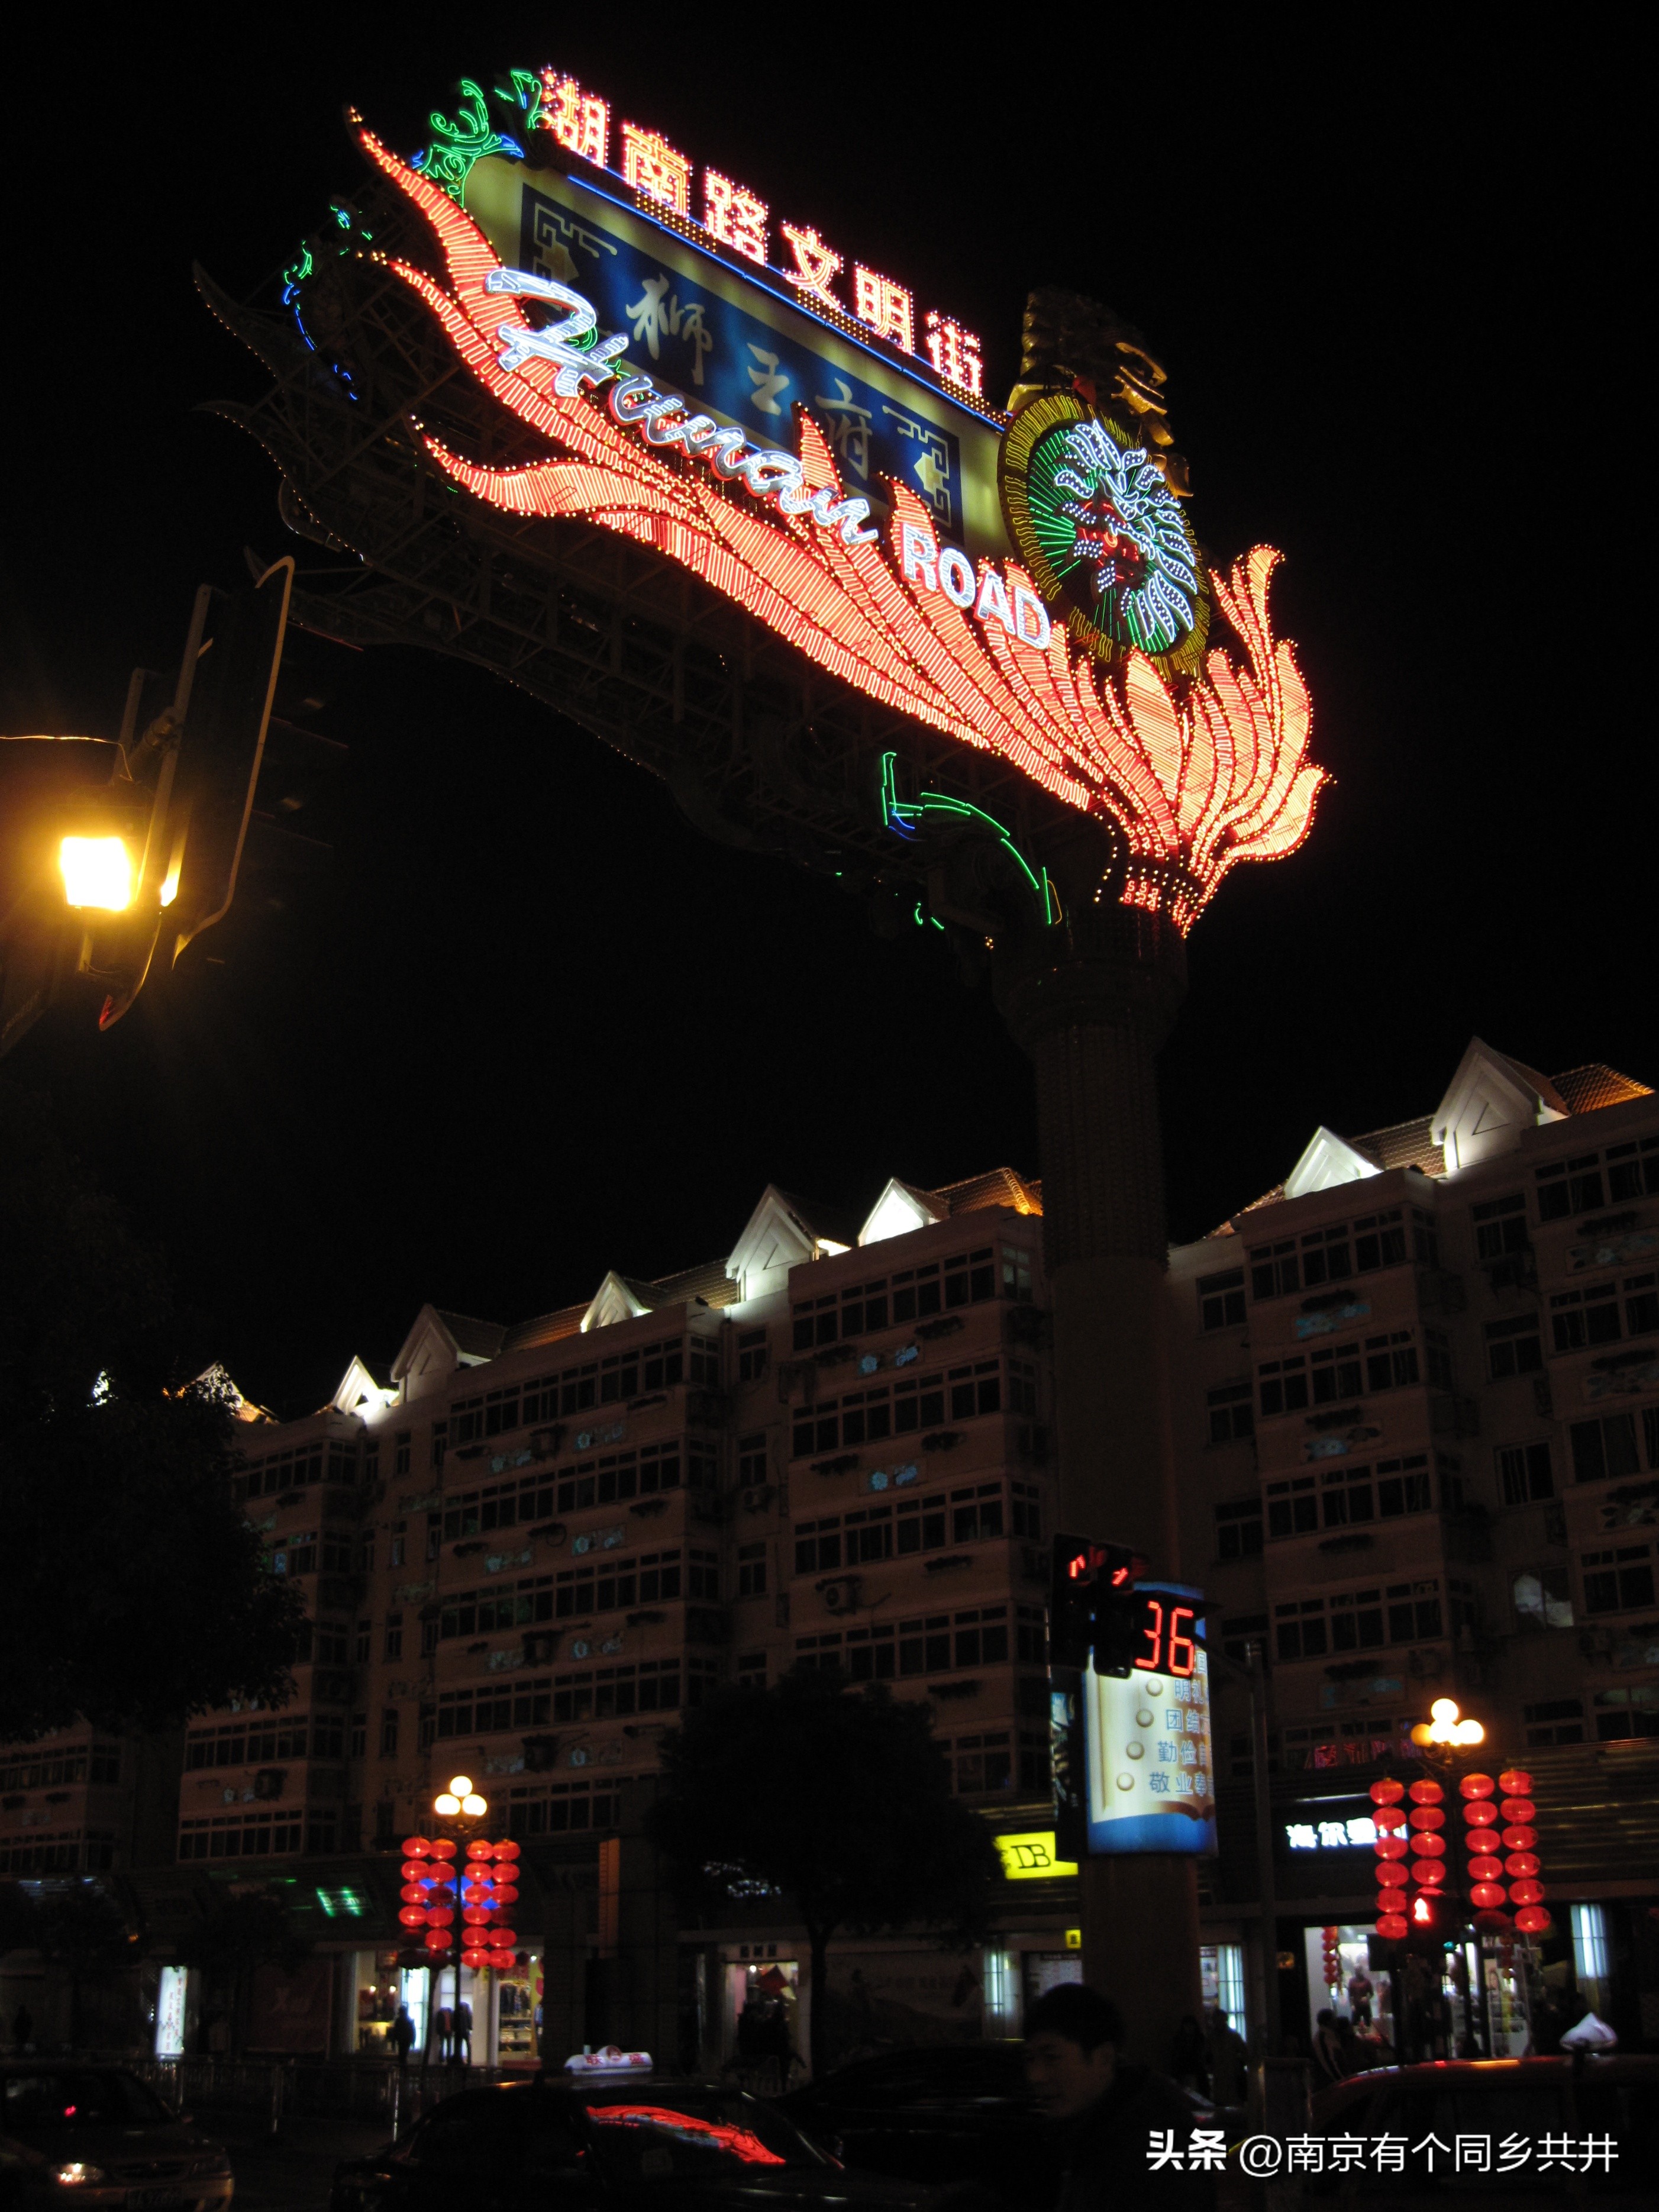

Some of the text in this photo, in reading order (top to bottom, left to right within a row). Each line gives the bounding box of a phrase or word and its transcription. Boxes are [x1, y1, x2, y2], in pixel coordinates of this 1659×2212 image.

[541, 67, 982, 398] 湖南路文明街
[485, 268, 1051, 650] Hunan ROAD
[1135, 1600, 1194, 1676] 36
[1174, 1679, 1209, 1705] 明礼
